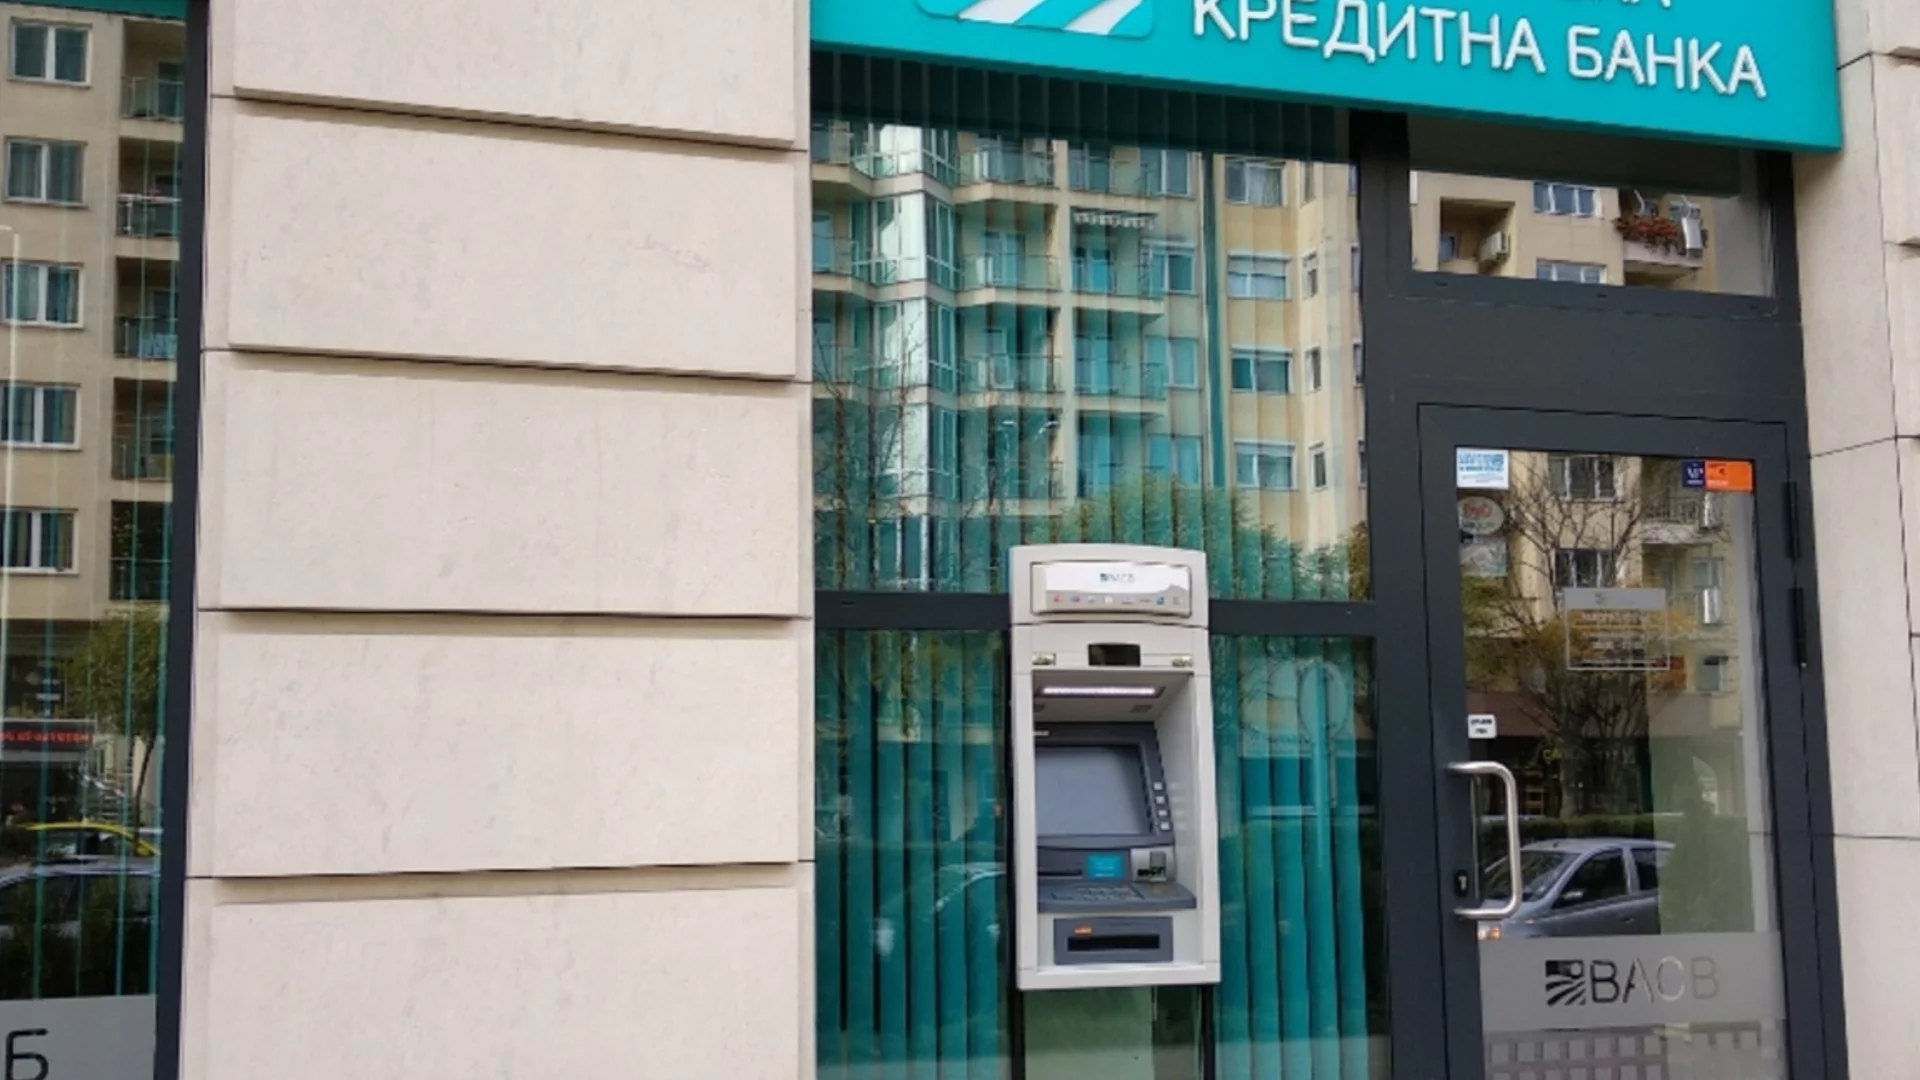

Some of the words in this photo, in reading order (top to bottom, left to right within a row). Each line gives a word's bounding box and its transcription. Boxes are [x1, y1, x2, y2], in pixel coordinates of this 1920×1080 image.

[1193, 0, 1546, 74] КРЕДИТНА
[1566, 25, 1767, 98] БАНКА
[1589, 956, 1720, 1004] BACB
